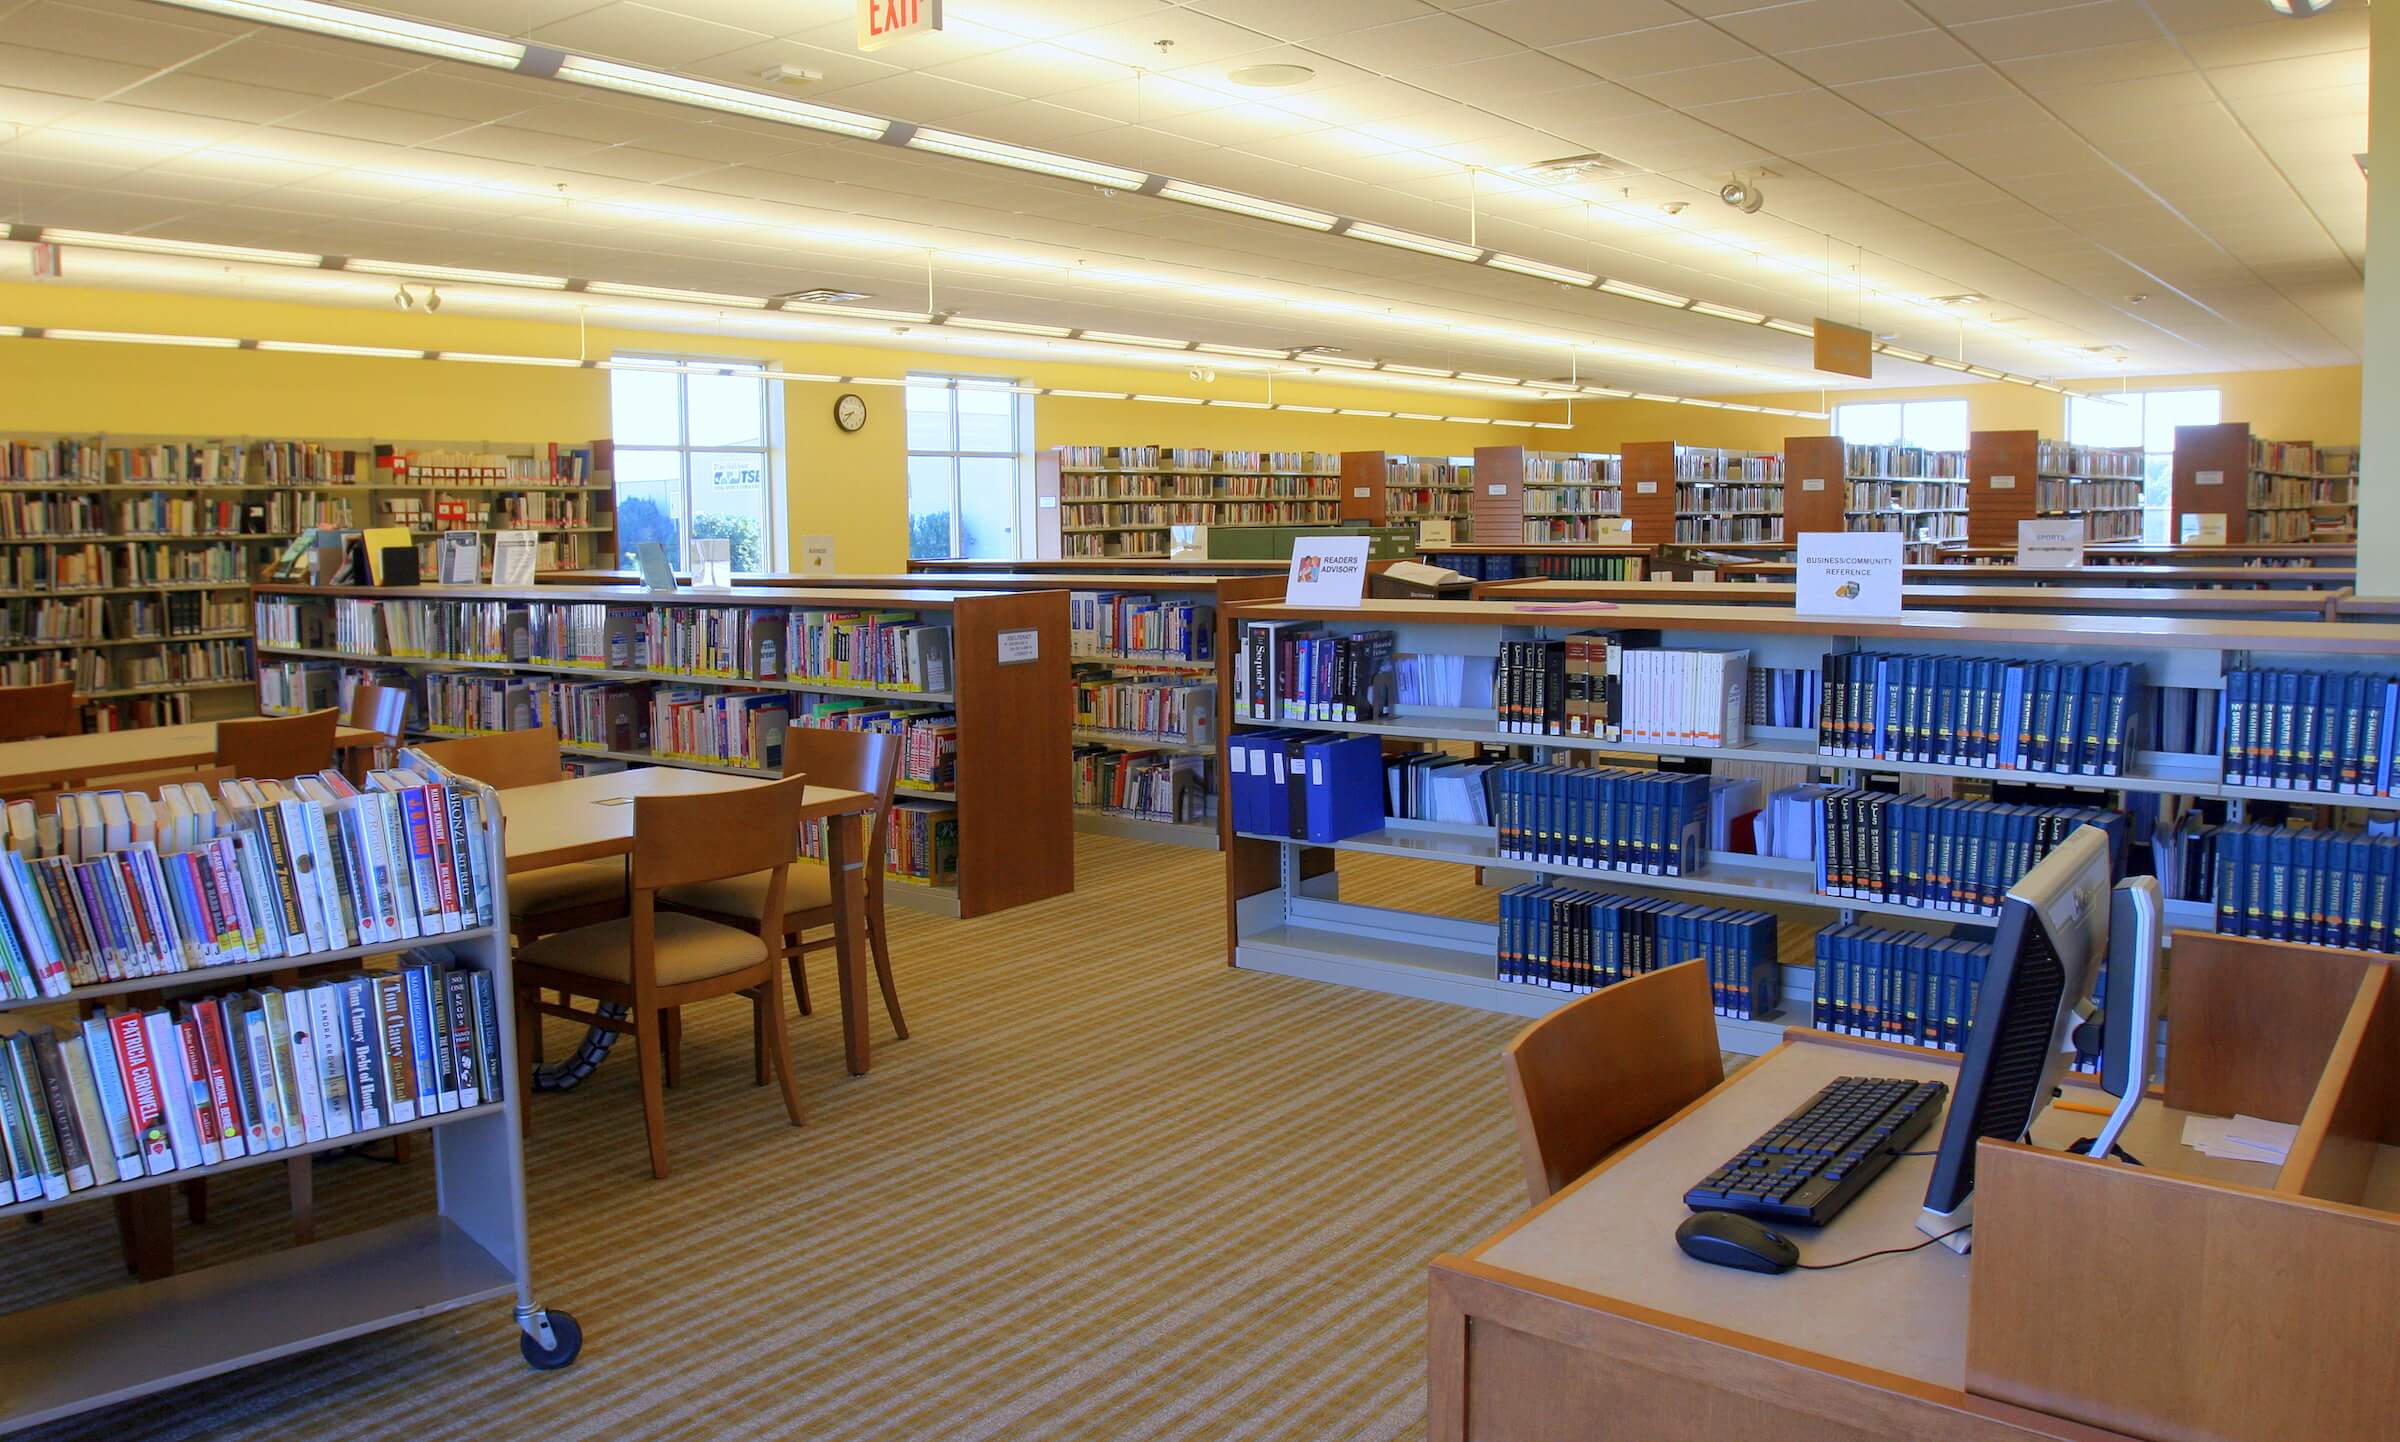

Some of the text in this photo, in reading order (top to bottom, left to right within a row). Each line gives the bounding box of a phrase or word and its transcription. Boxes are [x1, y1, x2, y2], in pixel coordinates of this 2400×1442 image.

[2037, 534, 2065, 542] SPORTS
[1323, 556, 1358, 564] READERS
[1806, 557, 1892, 565] BUSINESS/COMMUNITY
[2231, 712, 2239, 742] STATUTES
[2282, 714, 2291, 745] STATUTES
[430, 788, 446, 840] KILLING KENNEDY
[448, 793, 471, 896] BRONZE KIT REED
[211, 850, 230, 895] KARE KANO
[265, 811, 298, 934] MATTHEW REILLY 7 DEADLY WONDERS
[441, 866, 451, 879] BILL
[347, 984, 364, 1007] Tom
[382, 983, 404, 1013] Tom
[409, 976, 420, 999] MARY
[432, 979, 444, 1005] MICHAEL
[480, 979, 491, 999] New
[412, 998, 424, 1031] HIGGINS
[455, 993, 465, 1025] KNOWS
[481, 999, 494, 1026] Moon
[319, 1003, 336, 1076] SANDRA BROWN
[346, 1007, 370, 1045] Clancy
[382, 1014, 409, 1059] Clancy
[183, 1027, 202, 1077] John Grisham
[416, 1031, 427, 1056] CLARK
[439, 1036, 449, 1047] THE
[483, 1027, 496, 1055] Rising
[119, 1019, 161, 1123] PATRICIA CORNWELL
[355, 1045, 372, 1071] Debt
[439, 1047, 452, 1075] REVERSAL
[214, 1075, 228, 1106] MICHAEL
[359, 1072, 374, 1083] of
[200, 1111, 215, 1135] Calico
